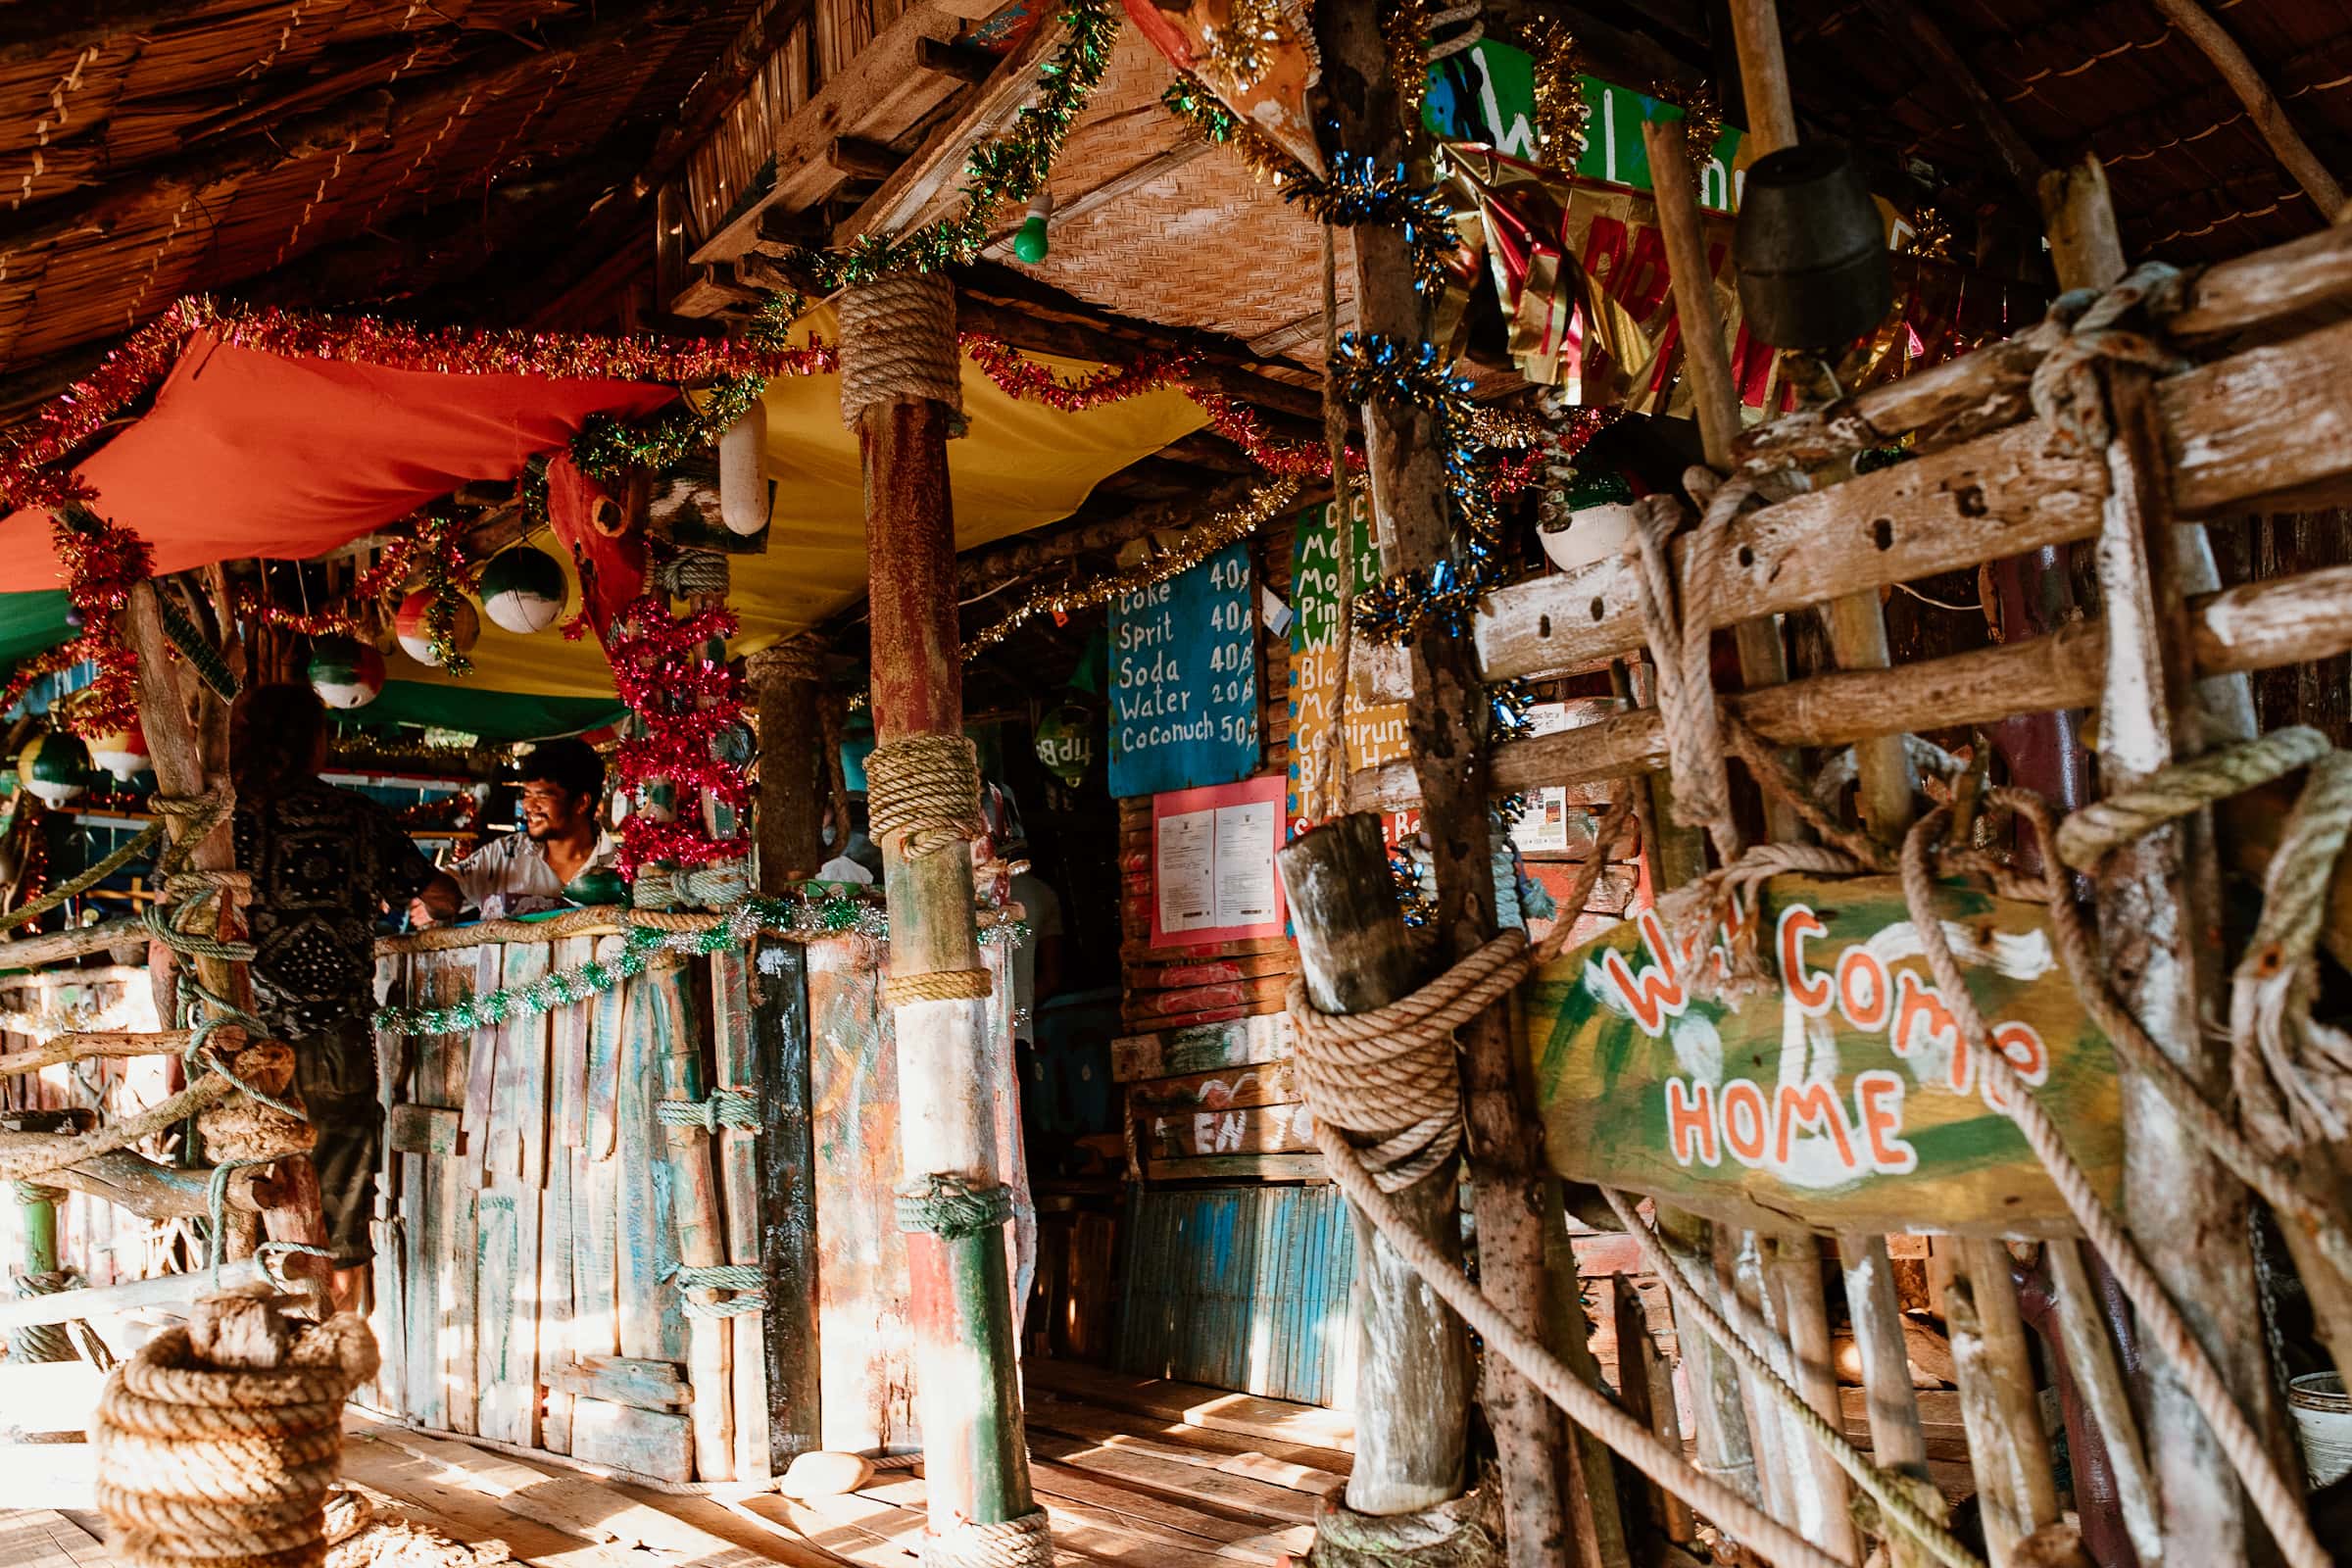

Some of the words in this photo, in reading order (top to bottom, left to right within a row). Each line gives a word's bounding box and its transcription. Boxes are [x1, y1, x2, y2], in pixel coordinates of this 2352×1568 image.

[1119, 612, 1174, 653] Sprit
[1119, 651, 1180, 689] Soda
[1120, 683, 1191, 721] Water
[1122, 710, 1214, 753] Coconuch
[1666, 1070, 1920, 1175] HOME
